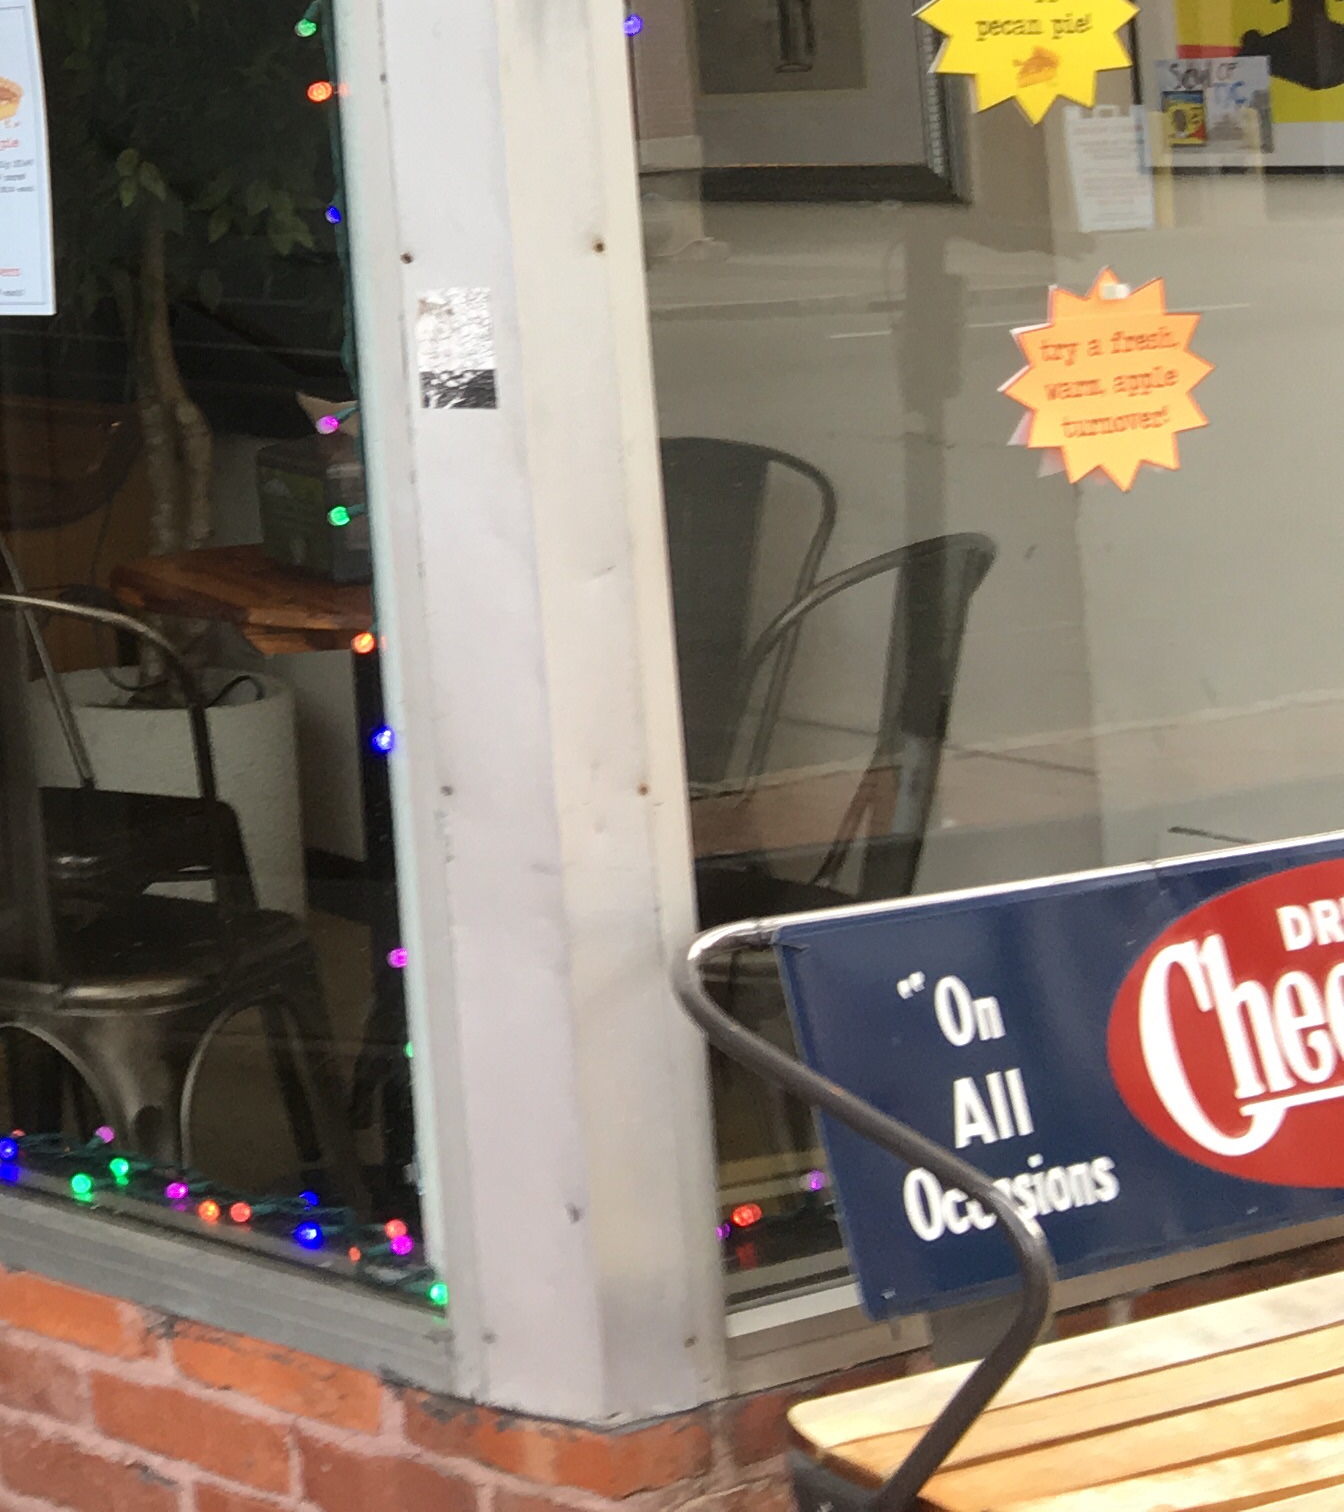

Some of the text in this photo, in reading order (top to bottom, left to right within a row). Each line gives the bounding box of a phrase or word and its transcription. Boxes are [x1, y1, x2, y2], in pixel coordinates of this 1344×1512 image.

[975, 17, 1044, 42] pecan
[1039, 325, 1181, 366] try a fresh
[1043, 365, 1180, 401] warm apple
[1276, 897, 1344, 952] DR
[952, 1067, 1035, 1149] All
[902, 1153, 1121, 1243] Occsions
